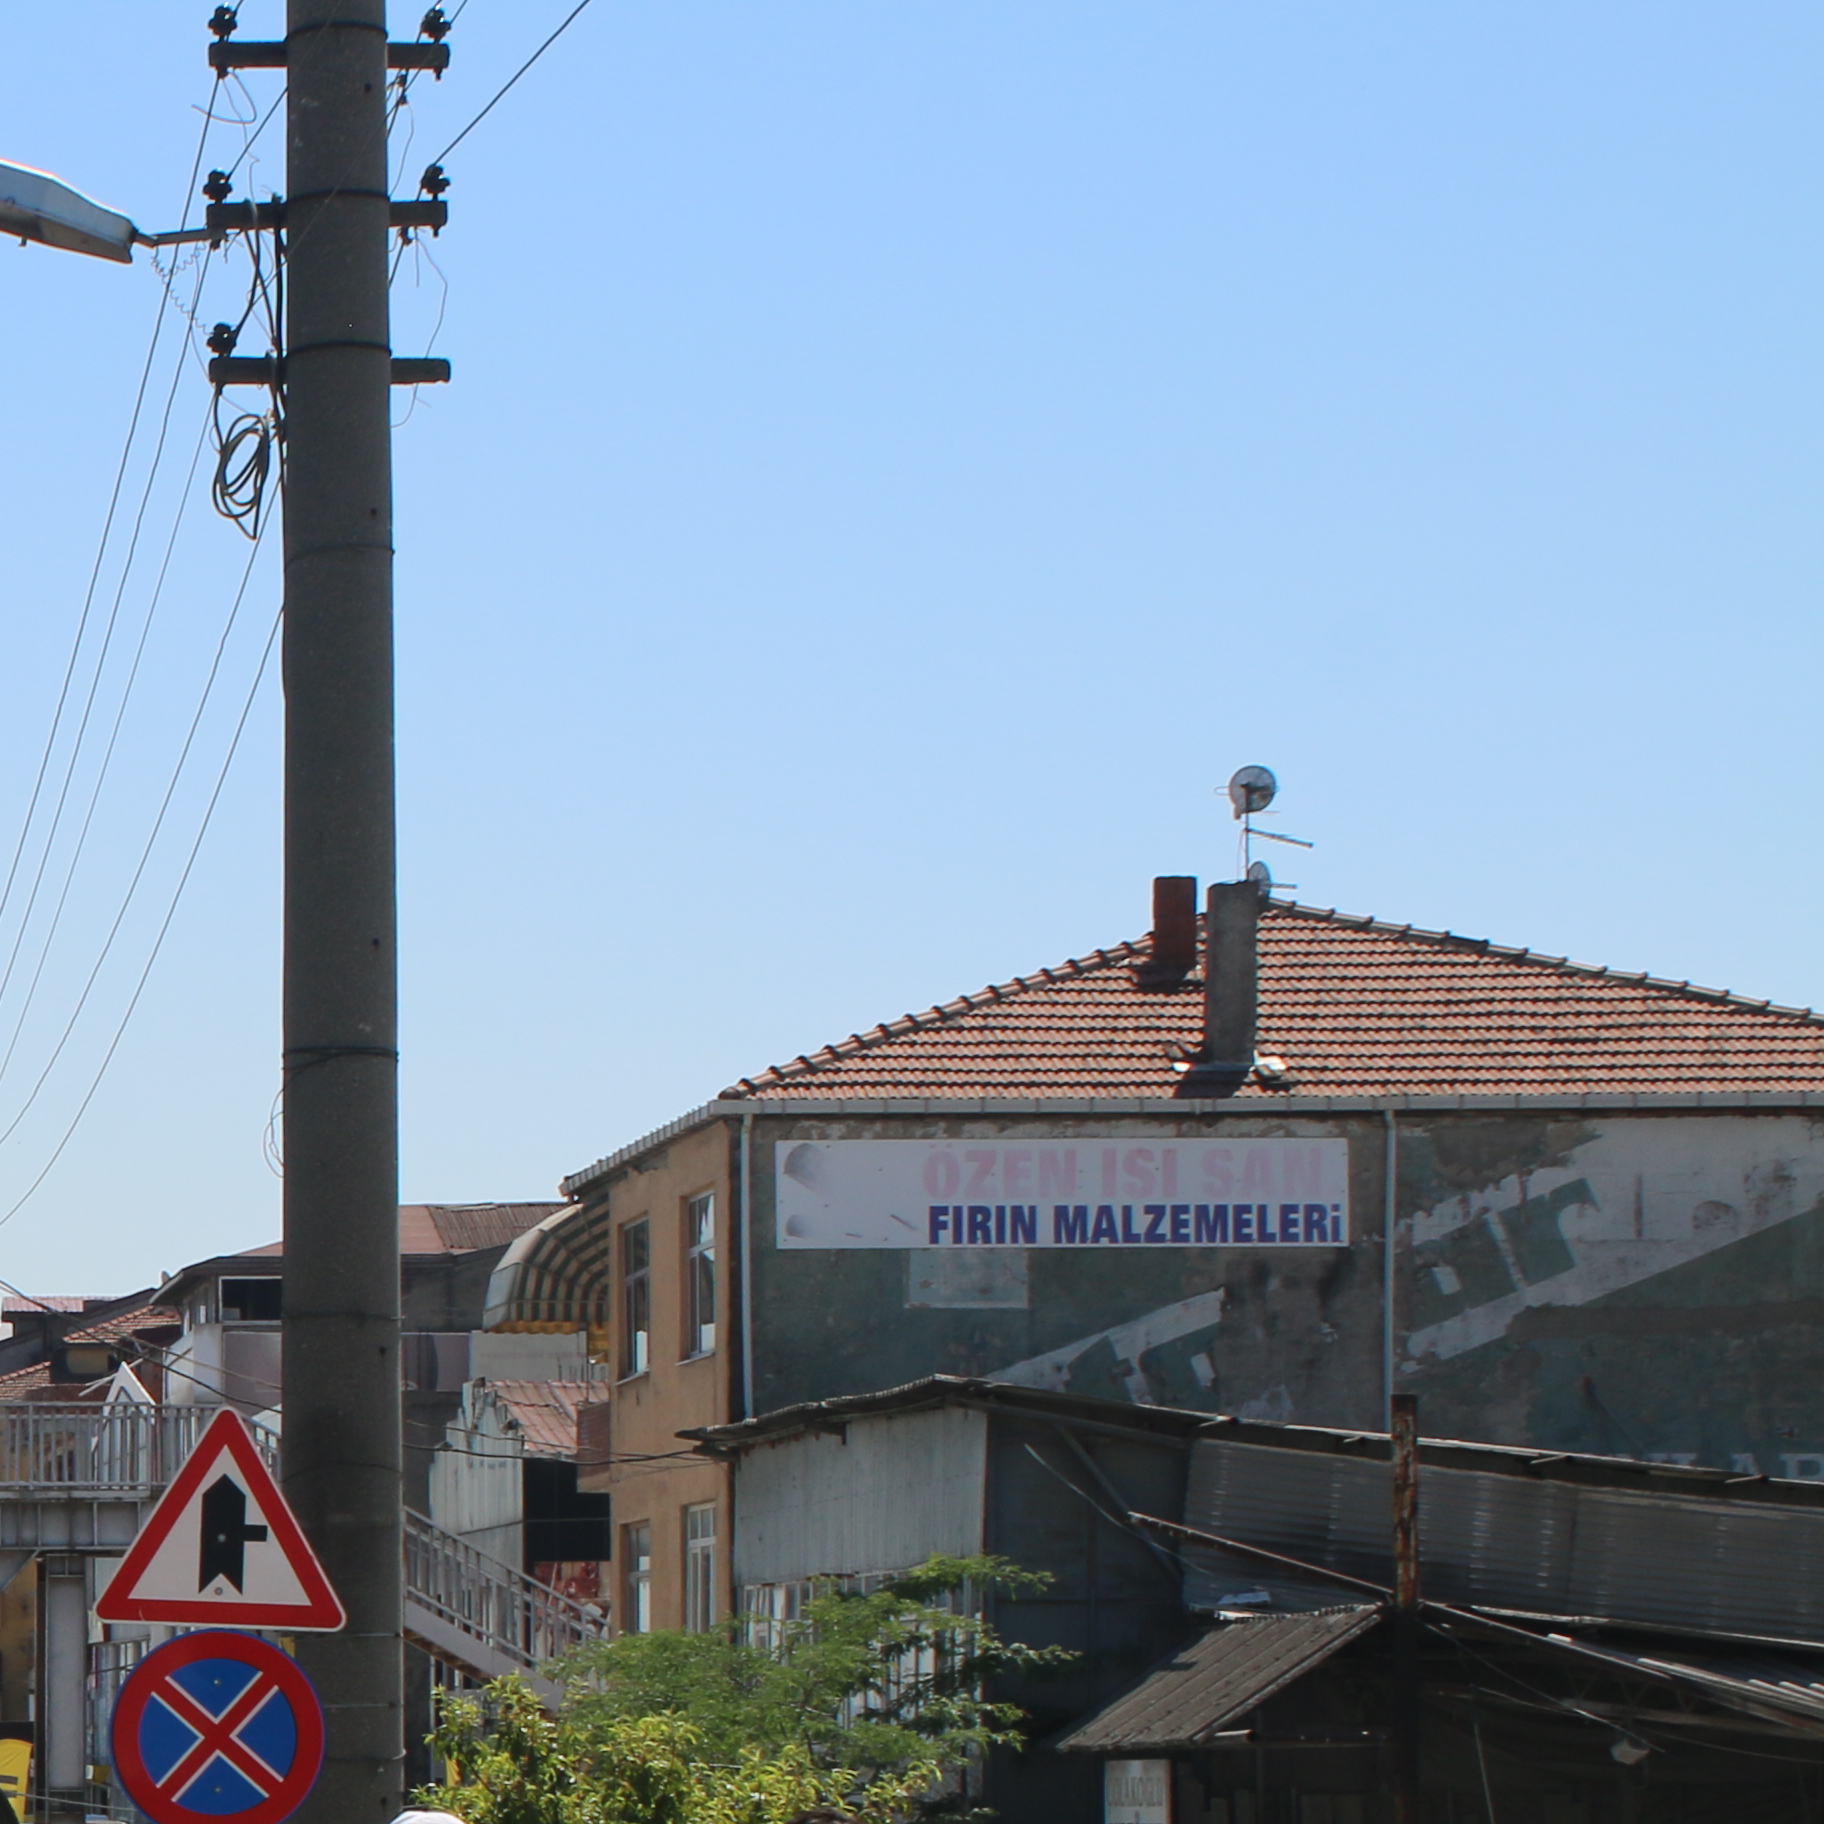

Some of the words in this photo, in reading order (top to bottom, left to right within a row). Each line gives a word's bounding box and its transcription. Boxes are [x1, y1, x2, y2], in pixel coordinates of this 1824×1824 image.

[924, 1143, 1078, 1199] ÖZEN
[1102, 1147, 1178, 1198] ISI
[1200, 1146, 1324, 1199] SAN
[928, 1205, 1038, 1245] FIRIN
[1053, 1203, 1342, 1245] MALZEMELERİ
